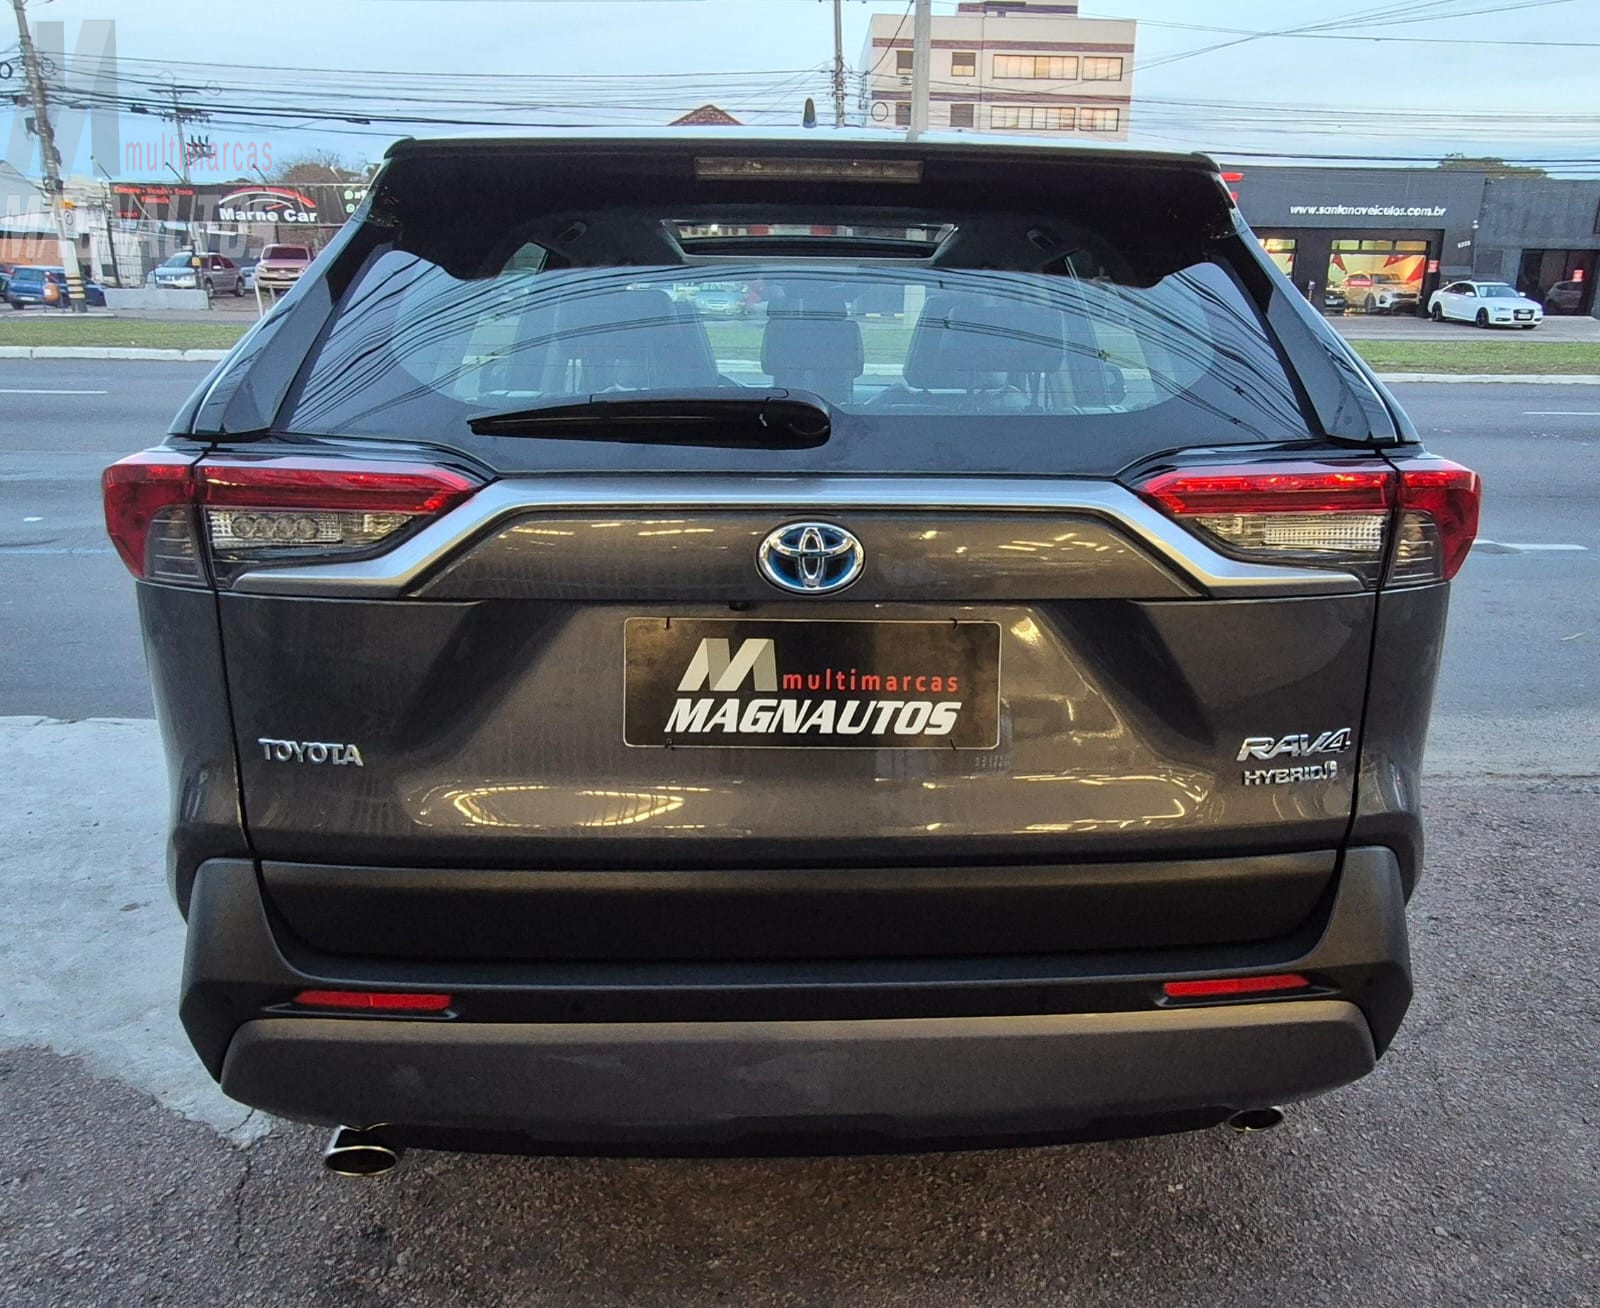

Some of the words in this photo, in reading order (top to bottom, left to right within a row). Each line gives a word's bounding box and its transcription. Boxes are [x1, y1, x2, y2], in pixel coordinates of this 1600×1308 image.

[218, 207, 279, 222] Marne
[283, 208, 318, 223] Car
[782, 669, 959, 692] multimarcas
[664, 698, 962, 736] MAGNAUTOS
[258, 738, 364, 767] TOYOTA
[1236, 728, 1352, 761] RAV4
[1243, 765, 1327, 786] HYBRID
